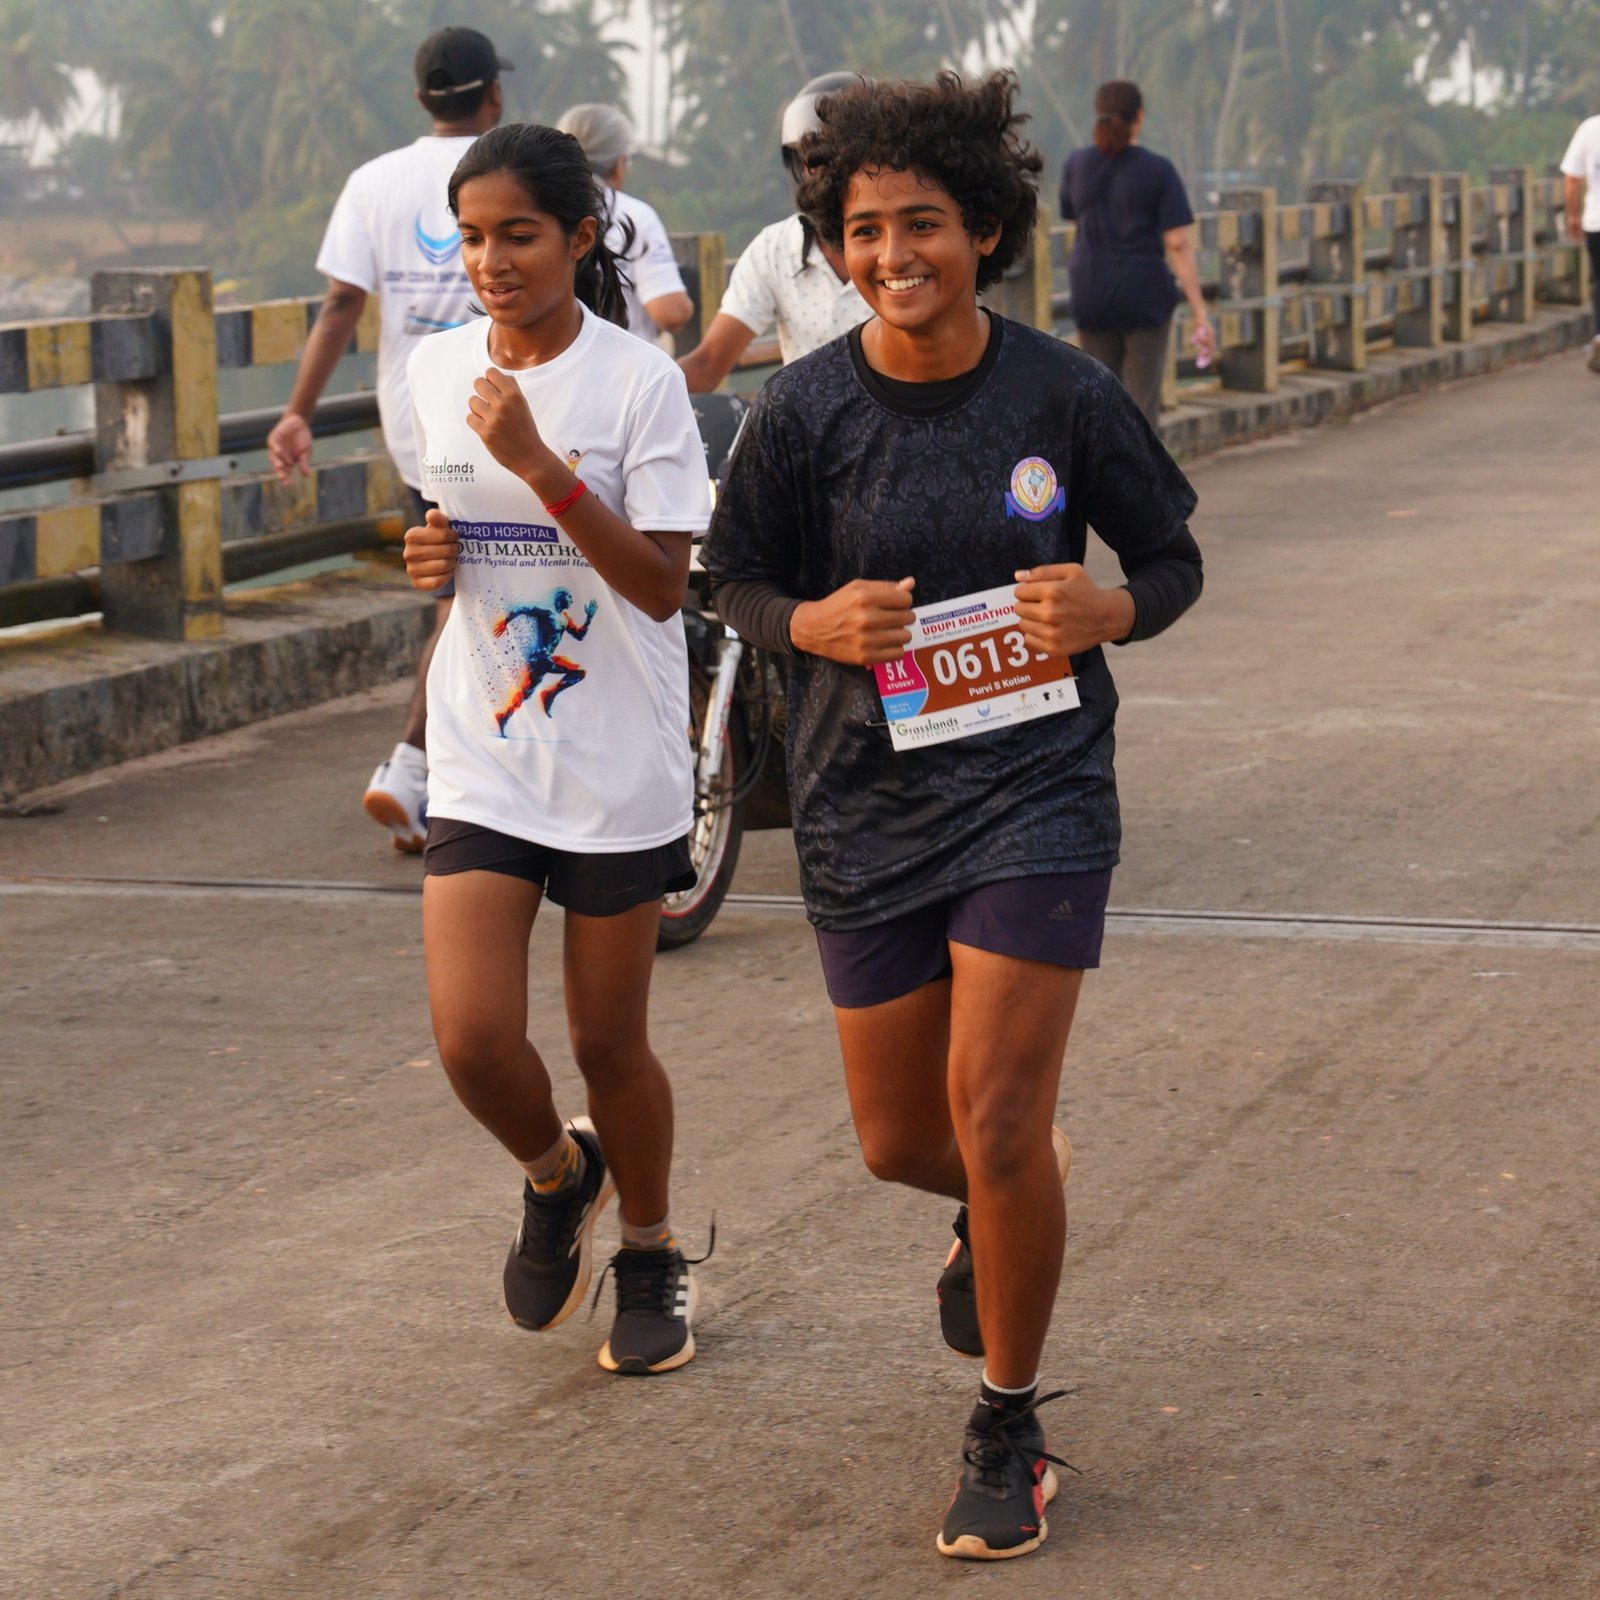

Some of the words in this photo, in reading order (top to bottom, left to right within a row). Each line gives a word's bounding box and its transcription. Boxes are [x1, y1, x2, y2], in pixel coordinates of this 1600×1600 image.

[494, 526, 554, 539] HOSPITAL
[494, 543, 584, 558] MARATHO
[519, 559, 536, 567] and
[538, 558, 570, 567] Mental
[923, 621, 955, 635] UDUPI
[932, 631, 1049, 685] 0613
[885, 662, 895, 681] 5
[895, 660, 908, 679] K
[969, 682, 993, 697] Purvi
[1002, 674, 1032, 688] Kotian
[896, 716, 958, 736] Grasslands
